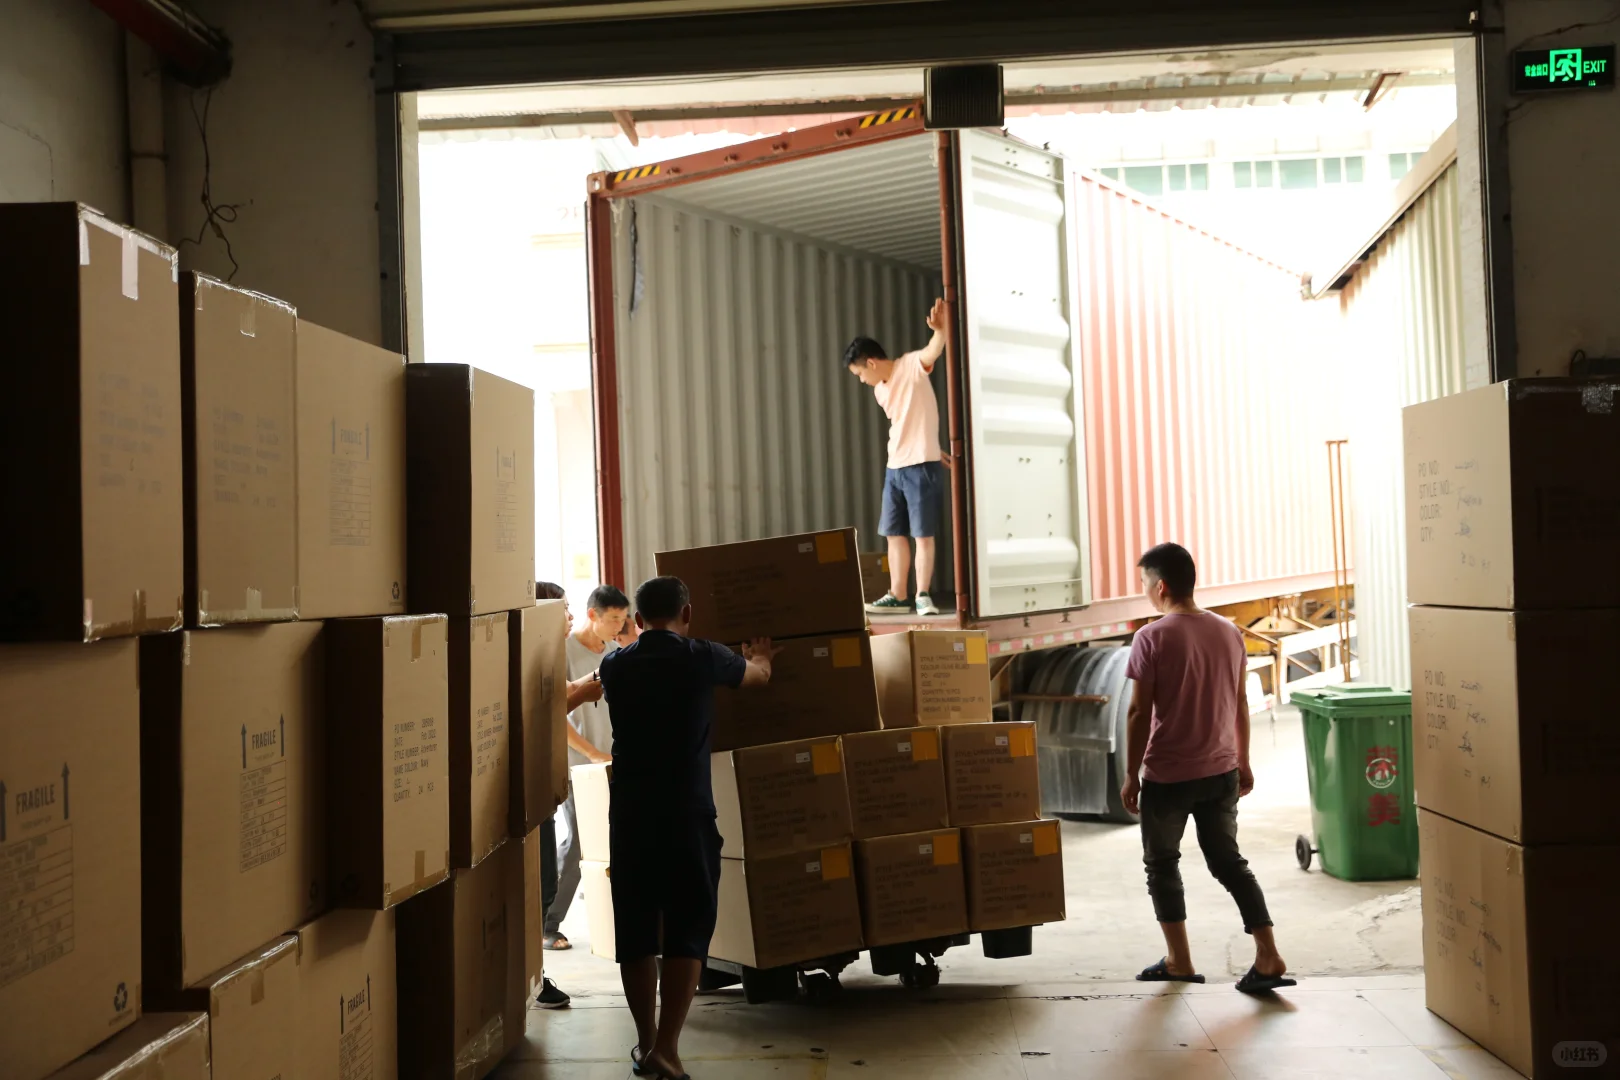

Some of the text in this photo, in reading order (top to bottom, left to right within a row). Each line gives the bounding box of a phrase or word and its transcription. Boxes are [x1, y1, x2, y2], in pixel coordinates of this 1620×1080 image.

[1583, 60, 1606, 73] EXIT
[1418, 462, 1427, 477] PO
[1419, 481, 1437, 499] STYLE
[1424, 670, 1433, 685] PO
[1425, 691, 1444, 708] STYLE
[251, 729, 277, 750] FRAGILE
[15, 783, 56, 815] FRAGILE
[347, 988, 365, 1015] FRAGILE
